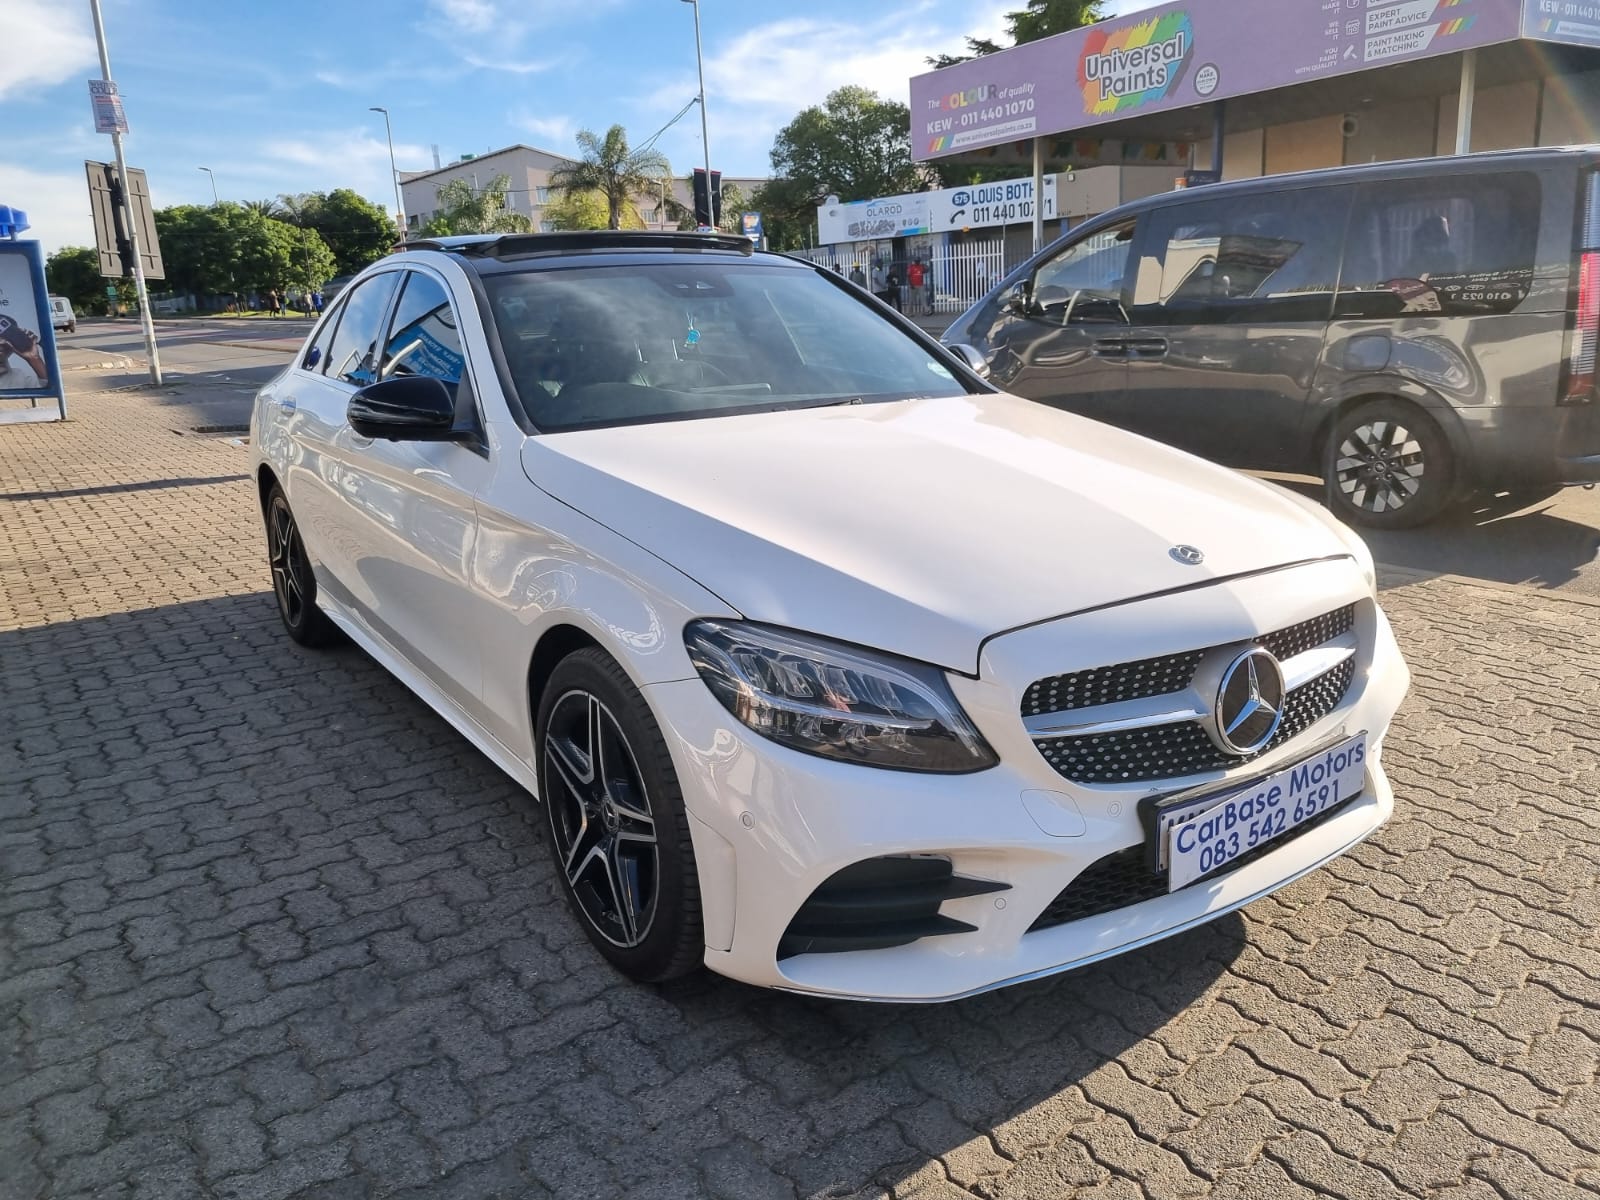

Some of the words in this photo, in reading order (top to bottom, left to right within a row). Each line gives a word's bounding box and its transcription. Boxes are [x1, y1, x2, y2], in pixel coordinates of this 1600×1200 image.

[1369, 8, 1400, 22] EXPERT
[1540, 0, 1560, 14] KEW
[1565, 4, 1577, 16] 011
[1579, 5, 1593, 19] 440
[1368, 19, 1393, 30] PAINT
[1394, 11, 1428, 24] ADVICE
[1368, 38, 1393, 49] PAINT
[1394, 30, 1424, 42] MIXING
[1374, 41, 1418, 56] MATCHING
[1086, 33, 1183, 79] Universal
[1312, 60, 1337, 71] QUALITY
[1102, 65, 1167, 98] Paints
[928, 100, 940, 110] The
[941, 84, 998, 112] COLOUR
[999, 87, 1008, 100] of
[1008, 82, 1036, 98] quality
[927, 117, 952, 134] KEW
[961, 111, 978, 126] 011
[980, 106, 1003, 122] 440
[1005, 98, 1034, 116] 1070
[972, 186, 1003, 205] LOUIS
[974, 206, 990, 222] 011
[993, 204, 1016, 220] 440
[1177, 786, 1282, 854] CarBase
[1289, 742, 1364, 798] Motors
[1200, 832, 1240, 872] 083
[1247, 808, 1286, 847] 542
[1293, 780, 1339, 823] 6591
